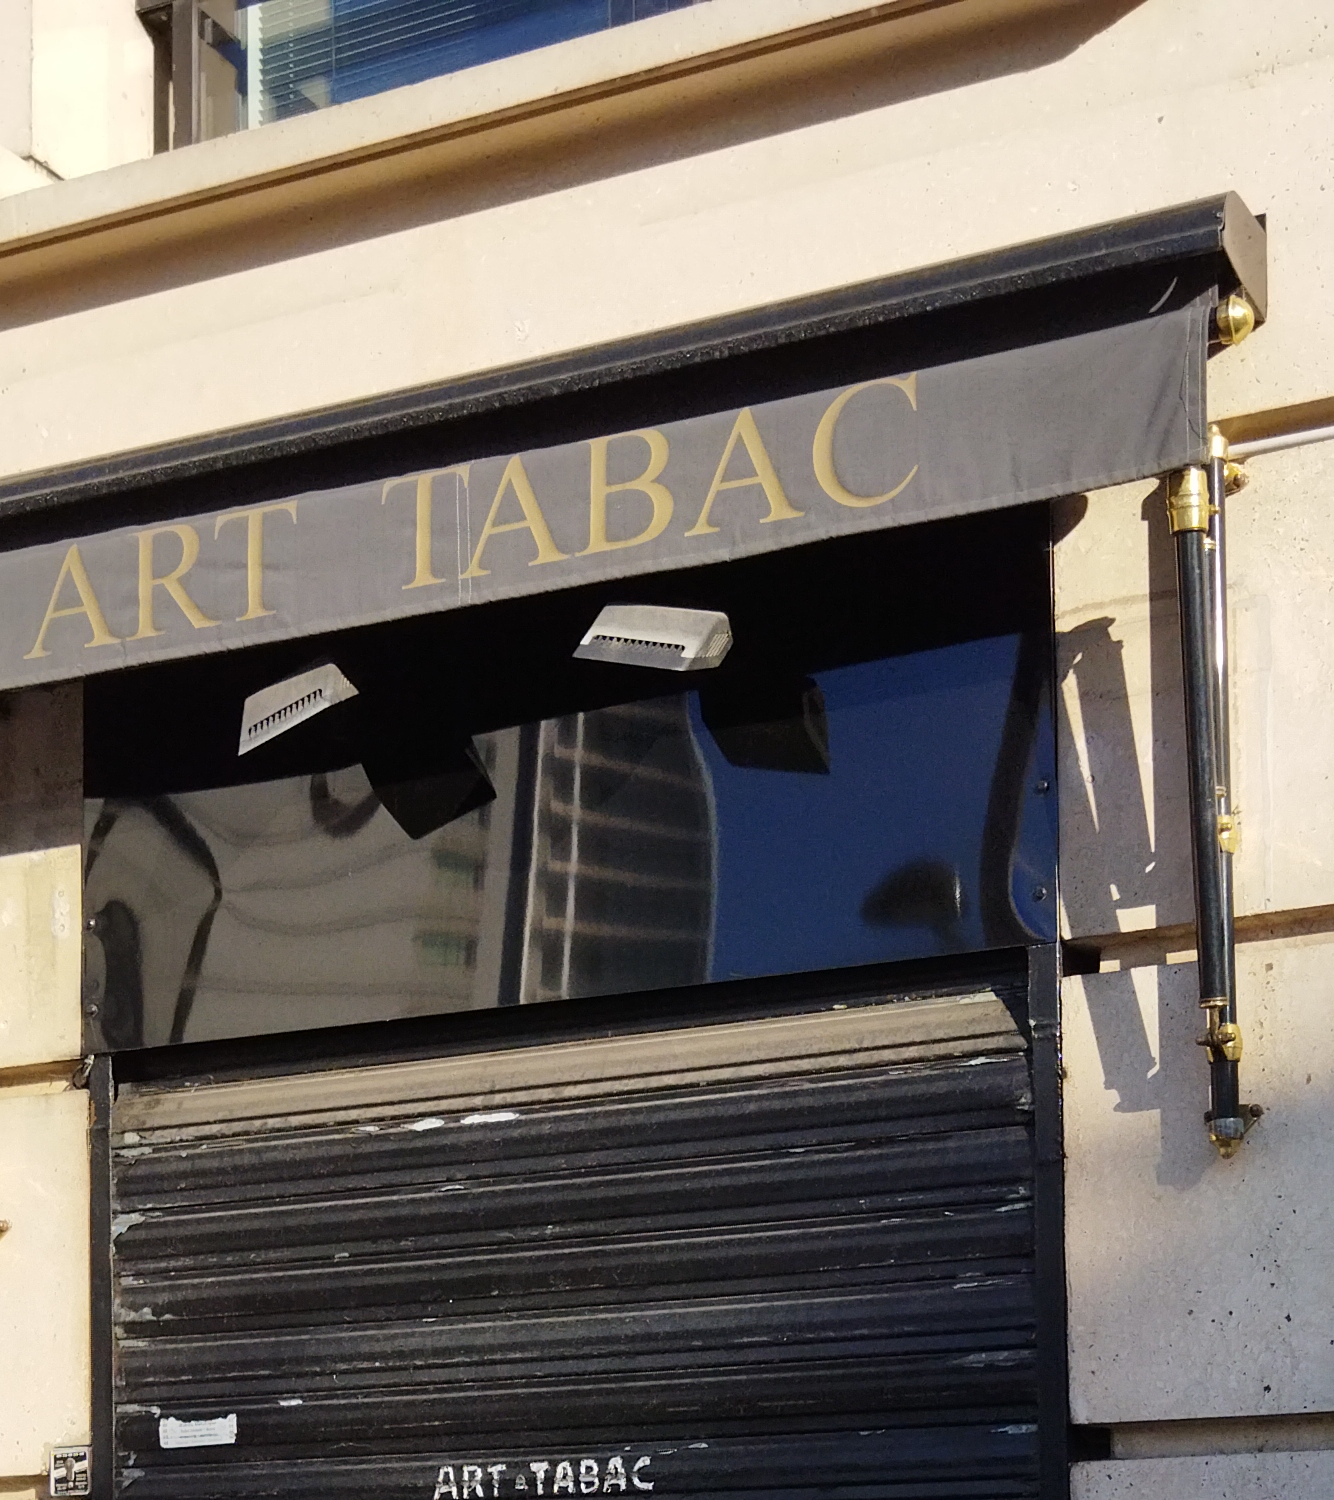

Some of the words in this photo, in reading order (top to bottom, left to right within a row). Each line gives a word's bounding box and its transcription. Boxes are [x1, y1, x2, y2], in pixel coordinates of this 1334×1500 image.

[22, 499, 299, 661] ART
[380, 370, 920, 591] TABAC
[529, 1455, 656, 1497] TABAC
